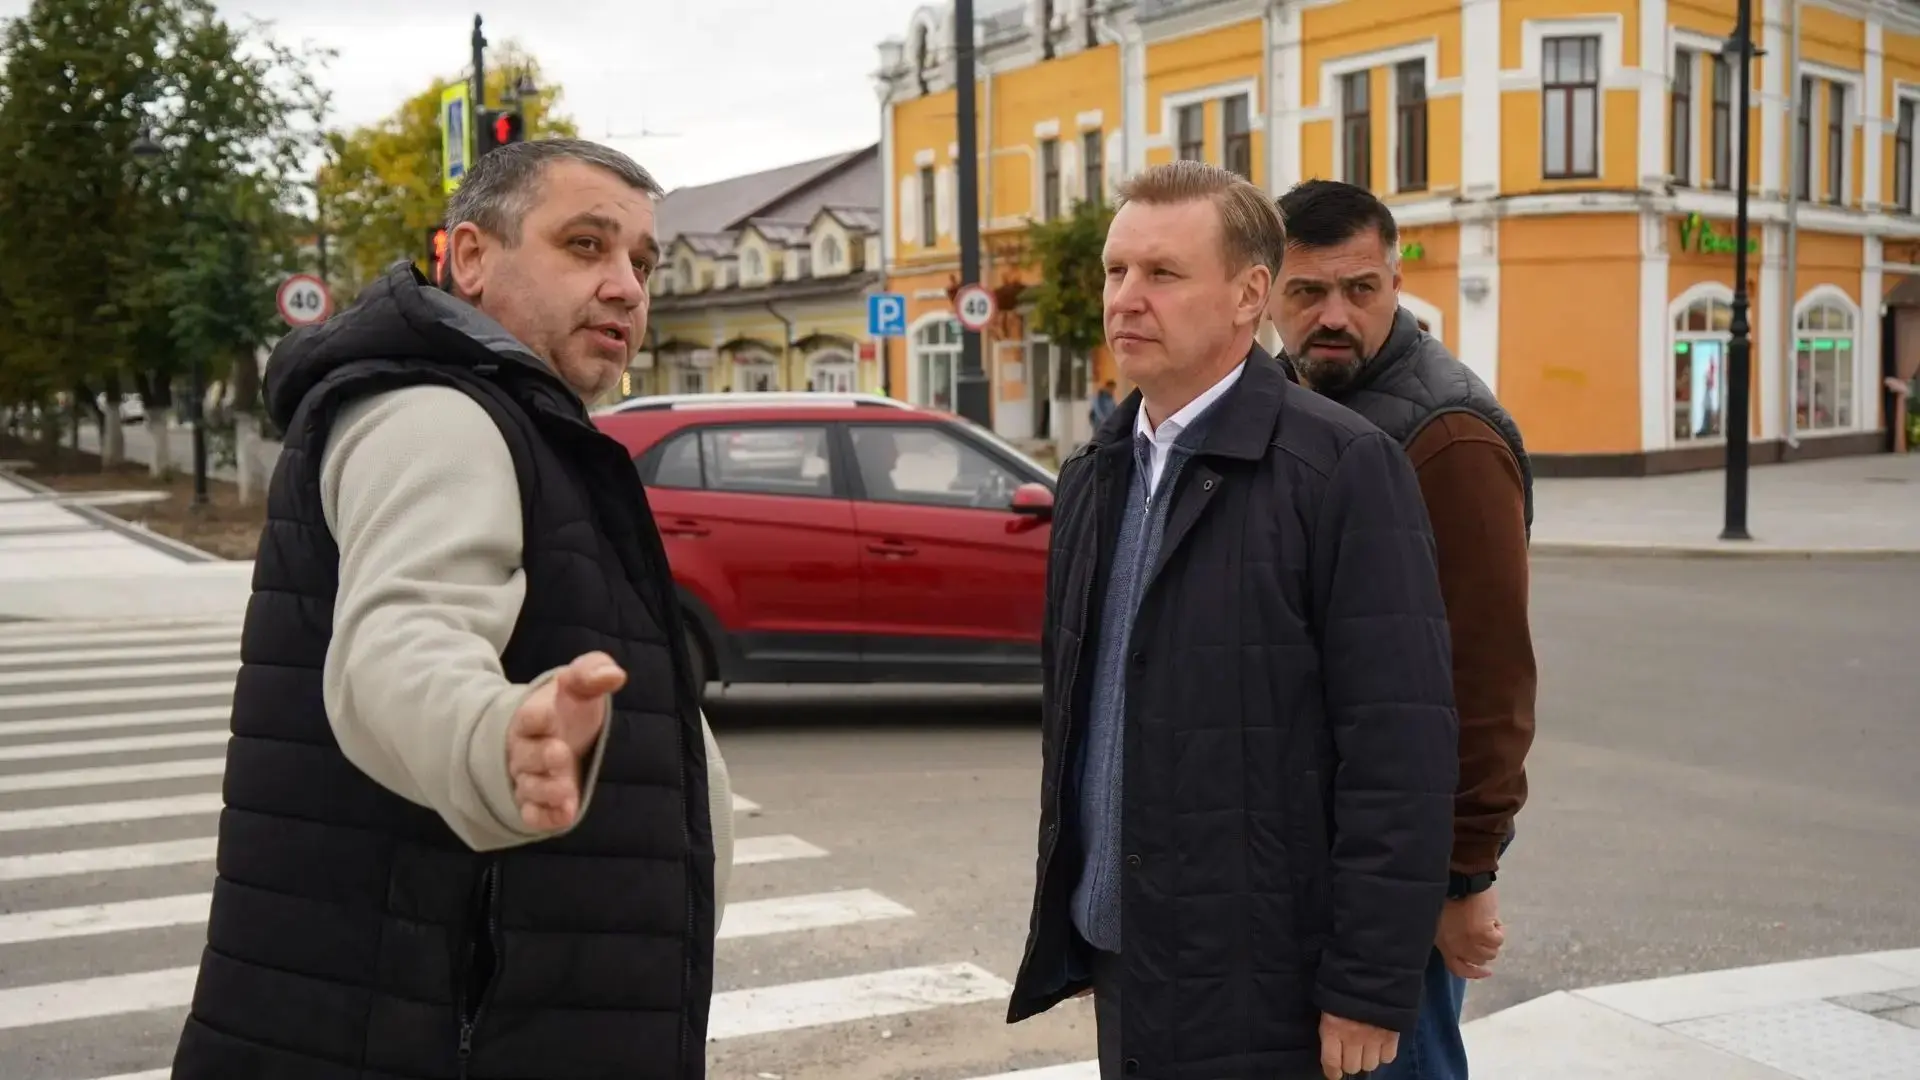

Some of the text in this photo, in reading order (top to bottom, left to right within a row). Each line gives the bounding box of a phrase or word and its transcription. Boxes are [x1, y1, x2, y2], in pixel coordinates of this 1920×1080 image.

[289, 290, 319, 310] 40
[965, 299, 987, 316] 40
[878, 299, 900, 331] P
